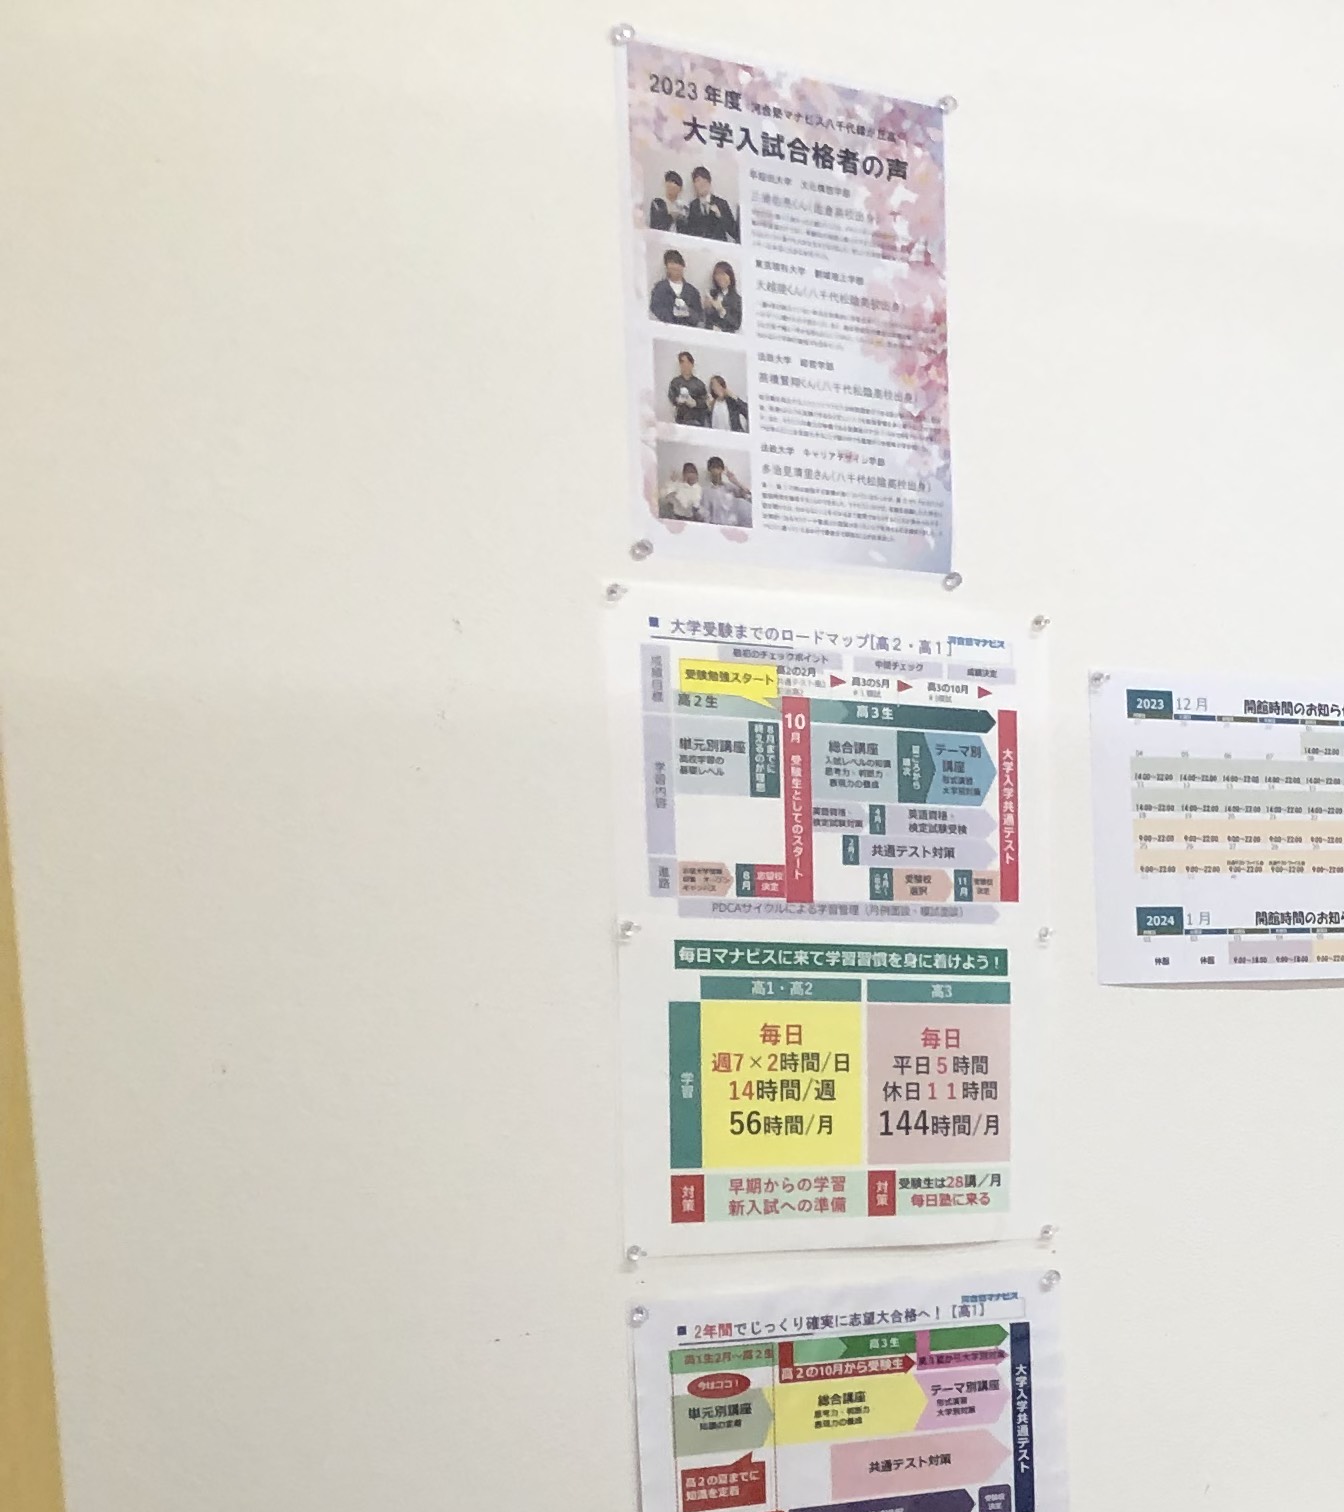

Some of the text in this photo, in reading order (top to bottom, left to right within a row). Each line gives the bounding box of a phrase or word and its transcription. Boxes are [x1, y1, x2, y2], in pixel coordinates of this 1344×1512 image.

[682, 116, 909, 182] 大学入試合格者の声
[685, 668, 774, 686] 受験勉強スタート
[678, 693, 894, 721] 高2生 高3生
[1136, 698, 1165, 710] 2023
[679, 737, 746, 755] 単元別講座
[828, 741, 879, 755] 総合講座
[1002, 748, 1015, 865] 大学入学共通テスト
[871, 844, 955, 859] 共通テスト対策
[1146, 915, 1175, 926] 2024
[679, 946, 1000, 970] 毎日マナビスに来て学習習慣を身に着けよう！
[931, 983, 953, 998] 高3
[760, 1024, 962, 1049] 毎日 毎日
[893, 1055, 989, 1075] 平日5時間
[728, 1078, 836, 1102] 14時間/週
[729, 1110, 1000, 1137] 56時間/月 144時間/月
[728, 1176, 846, 1194] 早期からの学習
[728, 1192, 991, 1215] 新入試への準備 毎日塾に来る
[781, 1358, 903, 1380] 高2の10月から受験生
[818, 1379, 1000, 1406] 総合講座 テーマ別講座
[688, 1403, 752, 1420] 単元別講座
[1015, 1364, 1030, 1473] 大学入学共通テスト
[869, 1453, 952, 1473] 共通テスト対策
